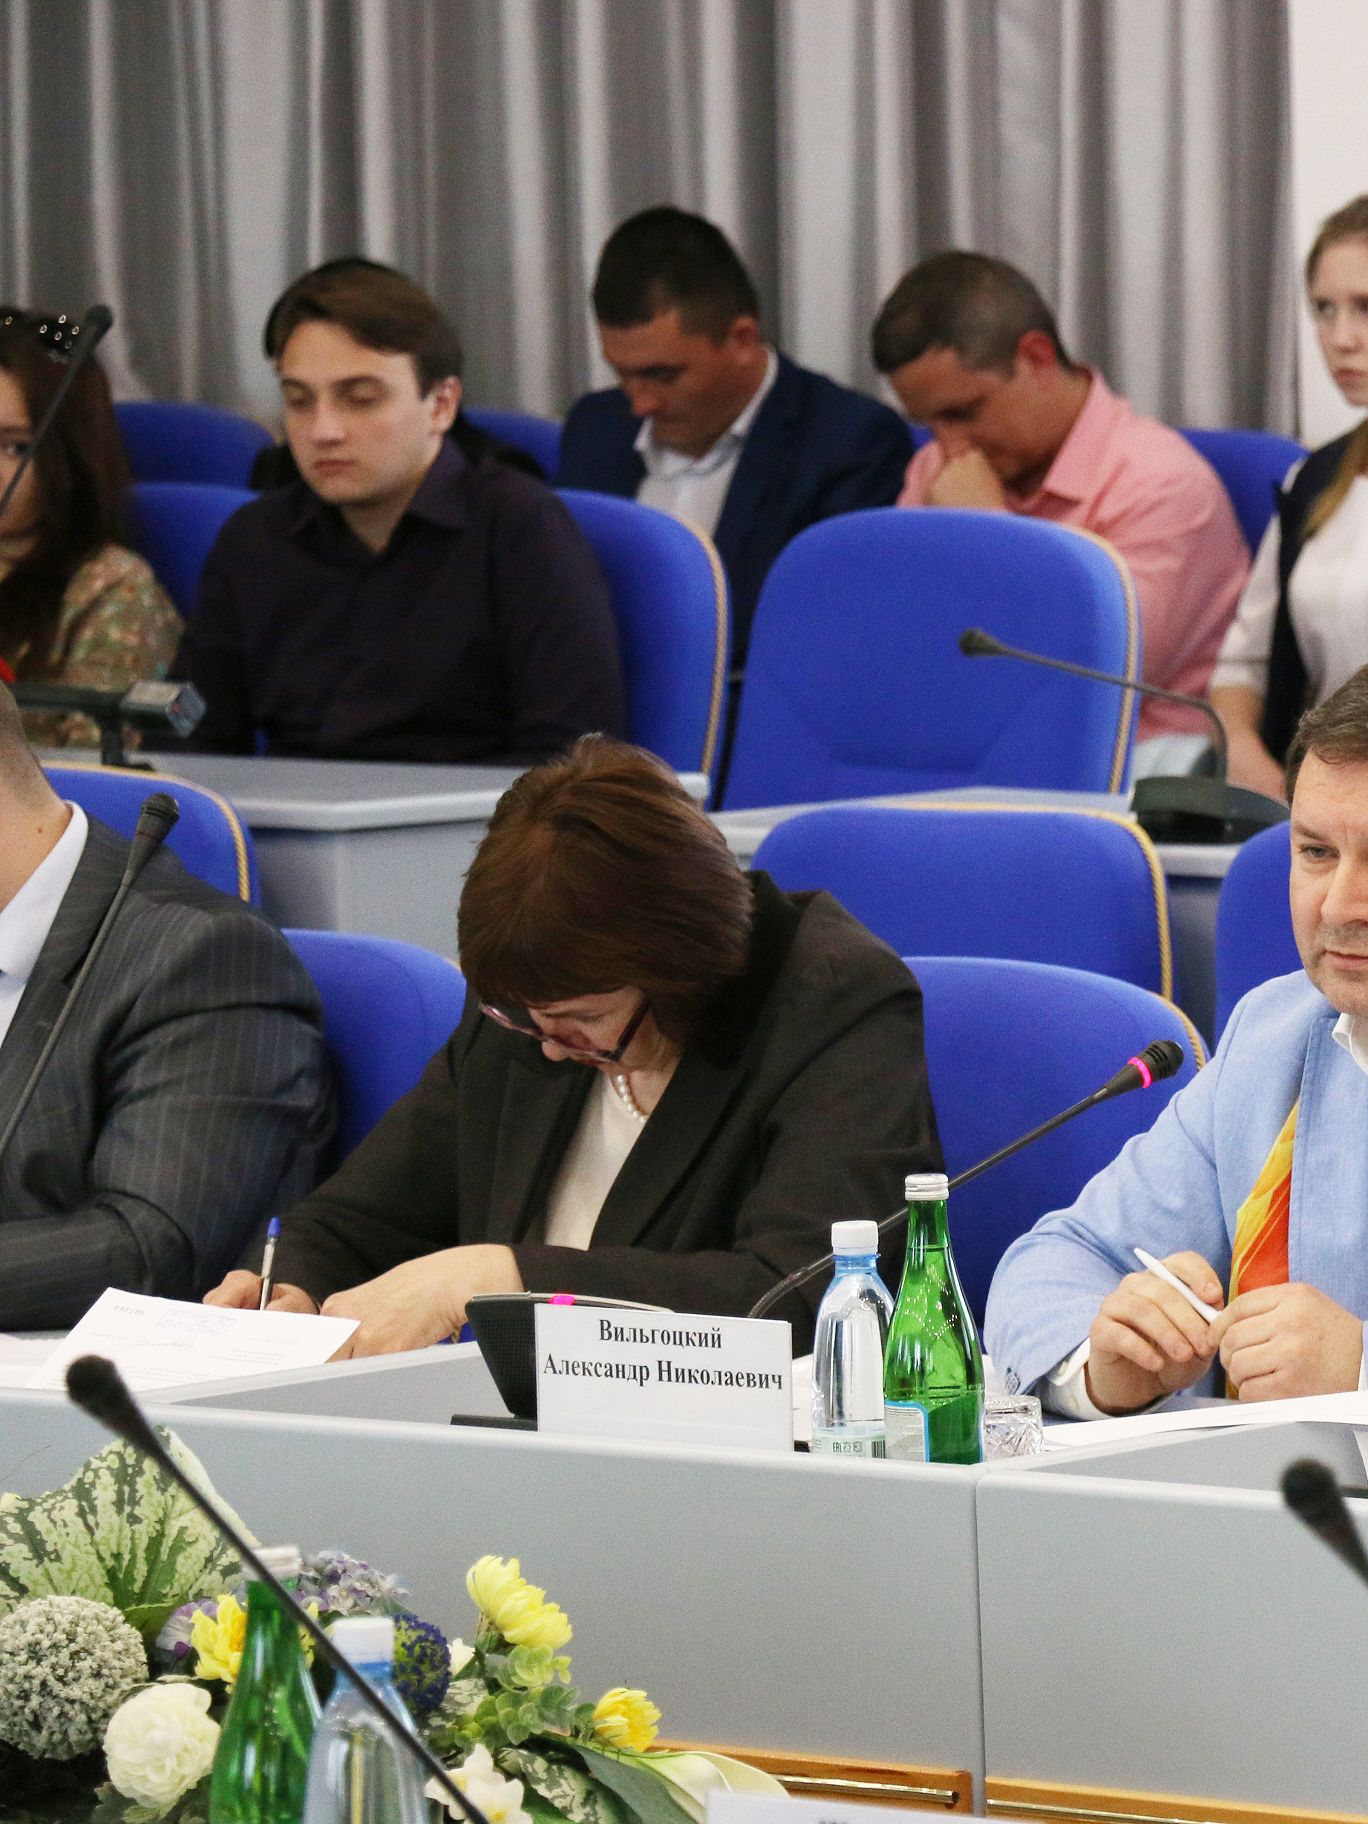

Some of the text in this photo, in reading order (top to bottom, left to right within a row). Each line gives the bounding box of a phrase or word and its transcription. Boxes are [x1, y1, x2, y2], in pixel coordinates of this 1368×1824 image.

[599, 1319, 723, 1349] Вильгоцкий
[543, 1354, 783, 1390] Александр Николаевич
